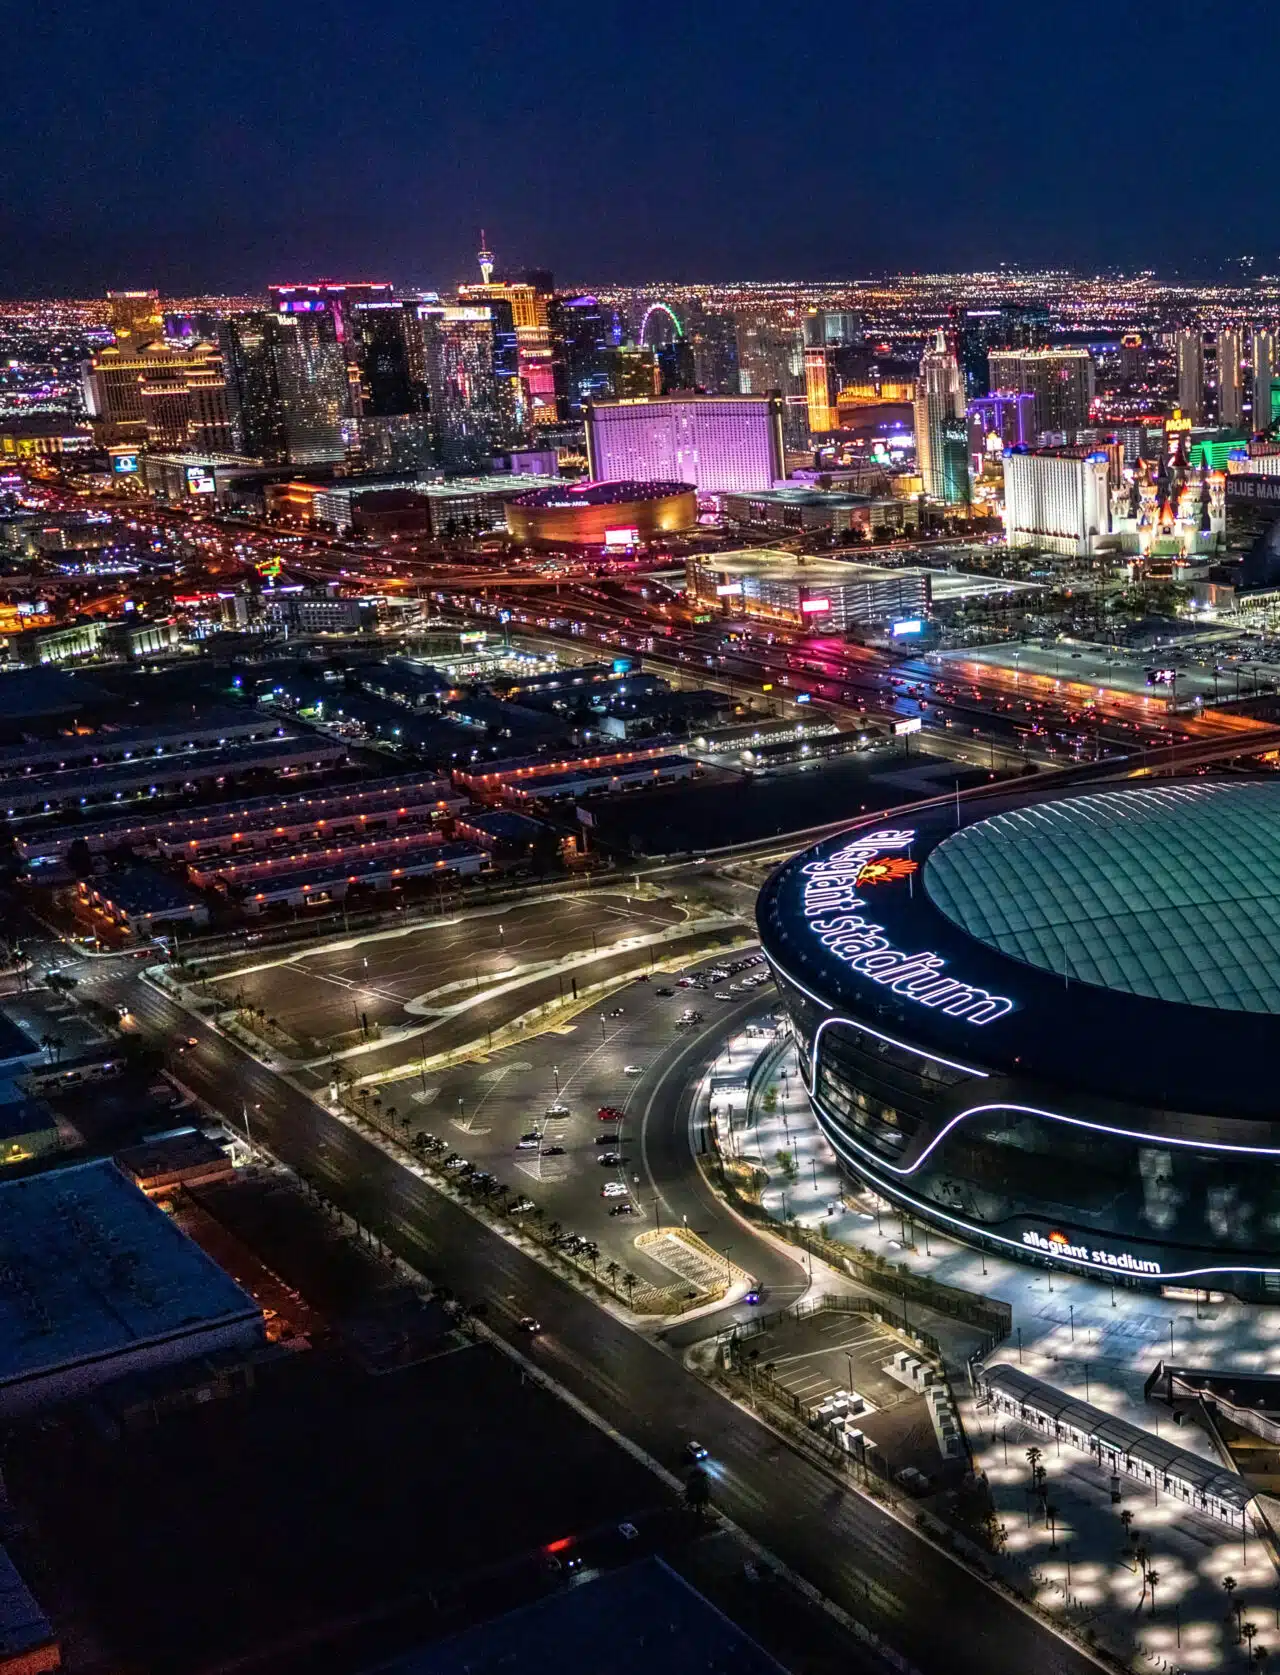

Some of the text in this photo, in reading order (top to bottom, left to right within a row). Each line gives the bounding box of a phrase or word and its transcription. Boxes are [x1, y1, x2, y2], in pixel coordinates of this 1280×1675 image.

[1165, 417, 1192, 432] MGM
[1226, 481, 1254, 497] BLUE
[1256, 484, 1280, 500] MAN
[802, 830, 1013, 1025] allegiant stadium
[1022, 1231, 1161, 1274] allegiant stadium
